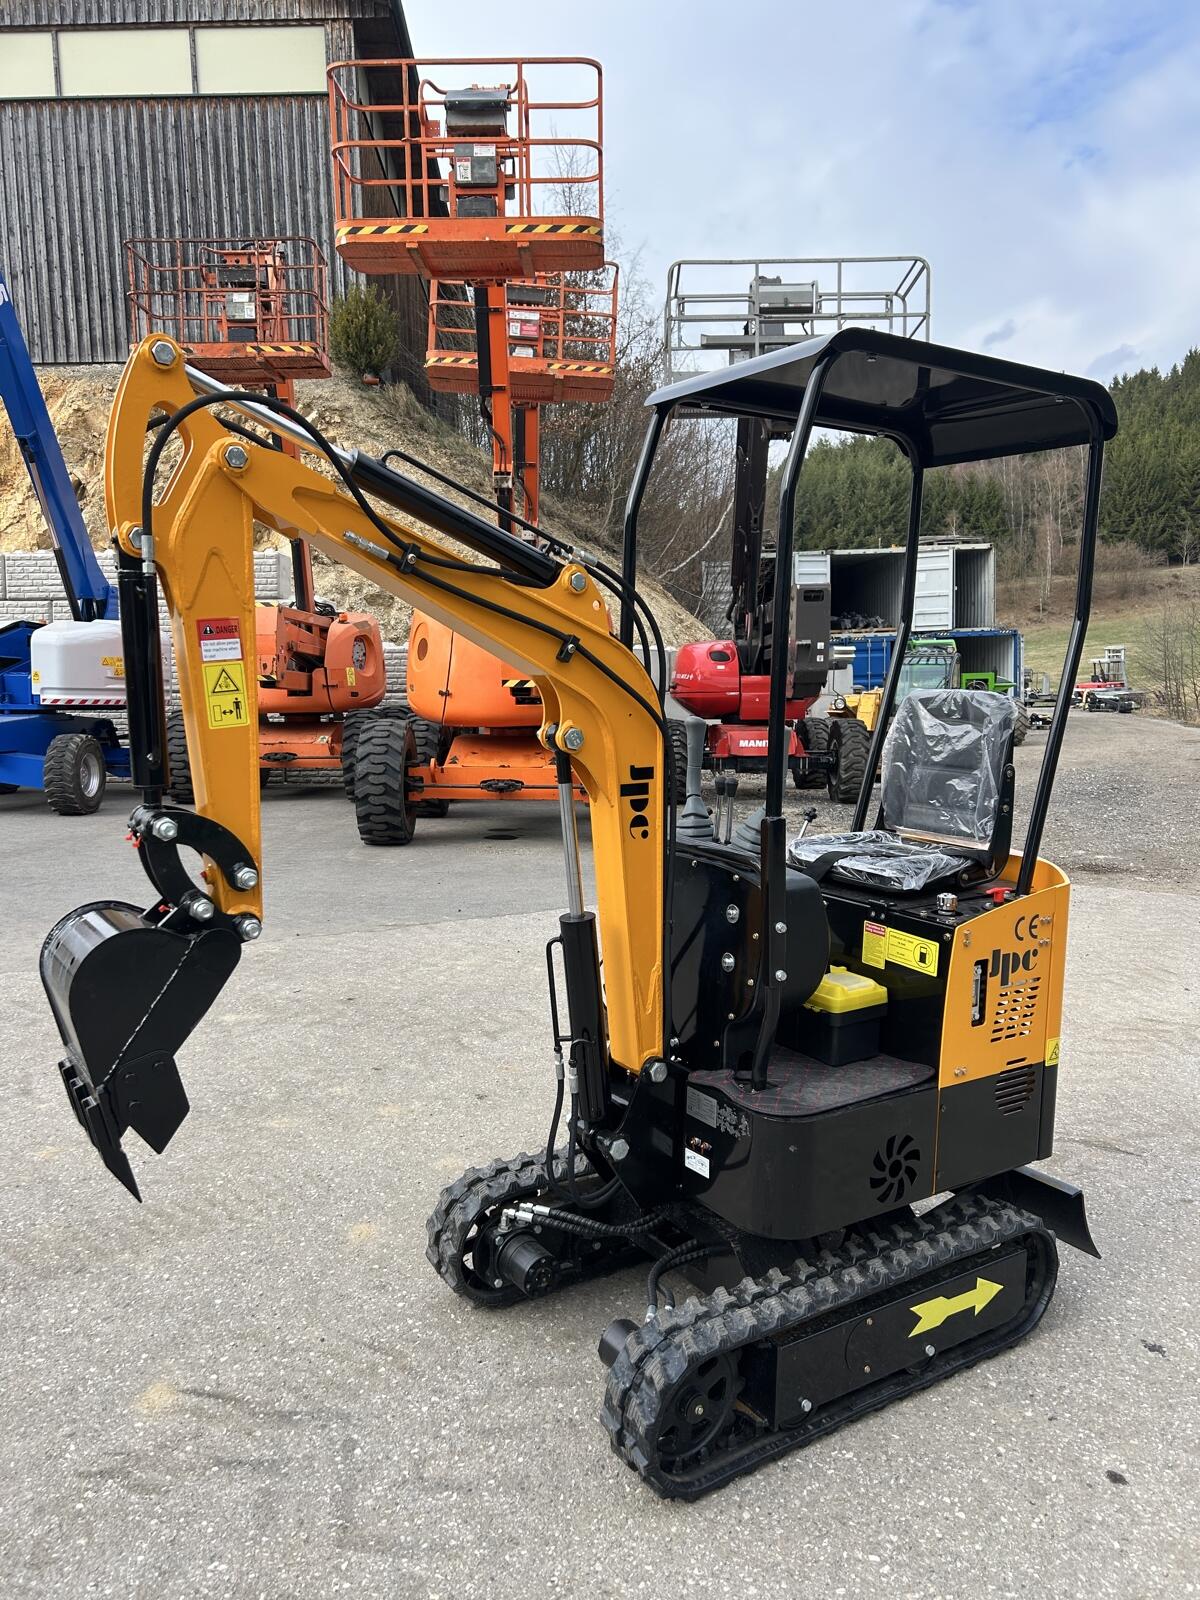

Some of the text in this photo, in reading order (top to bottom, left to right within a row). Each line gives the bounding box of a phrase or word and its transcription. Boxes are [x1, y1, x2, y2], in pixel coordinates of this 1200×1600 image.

[216, 625, 238, 633] DANGER
[739, 739, 768, 748] MANIT
[1015, 914, 1039, 941] CE
